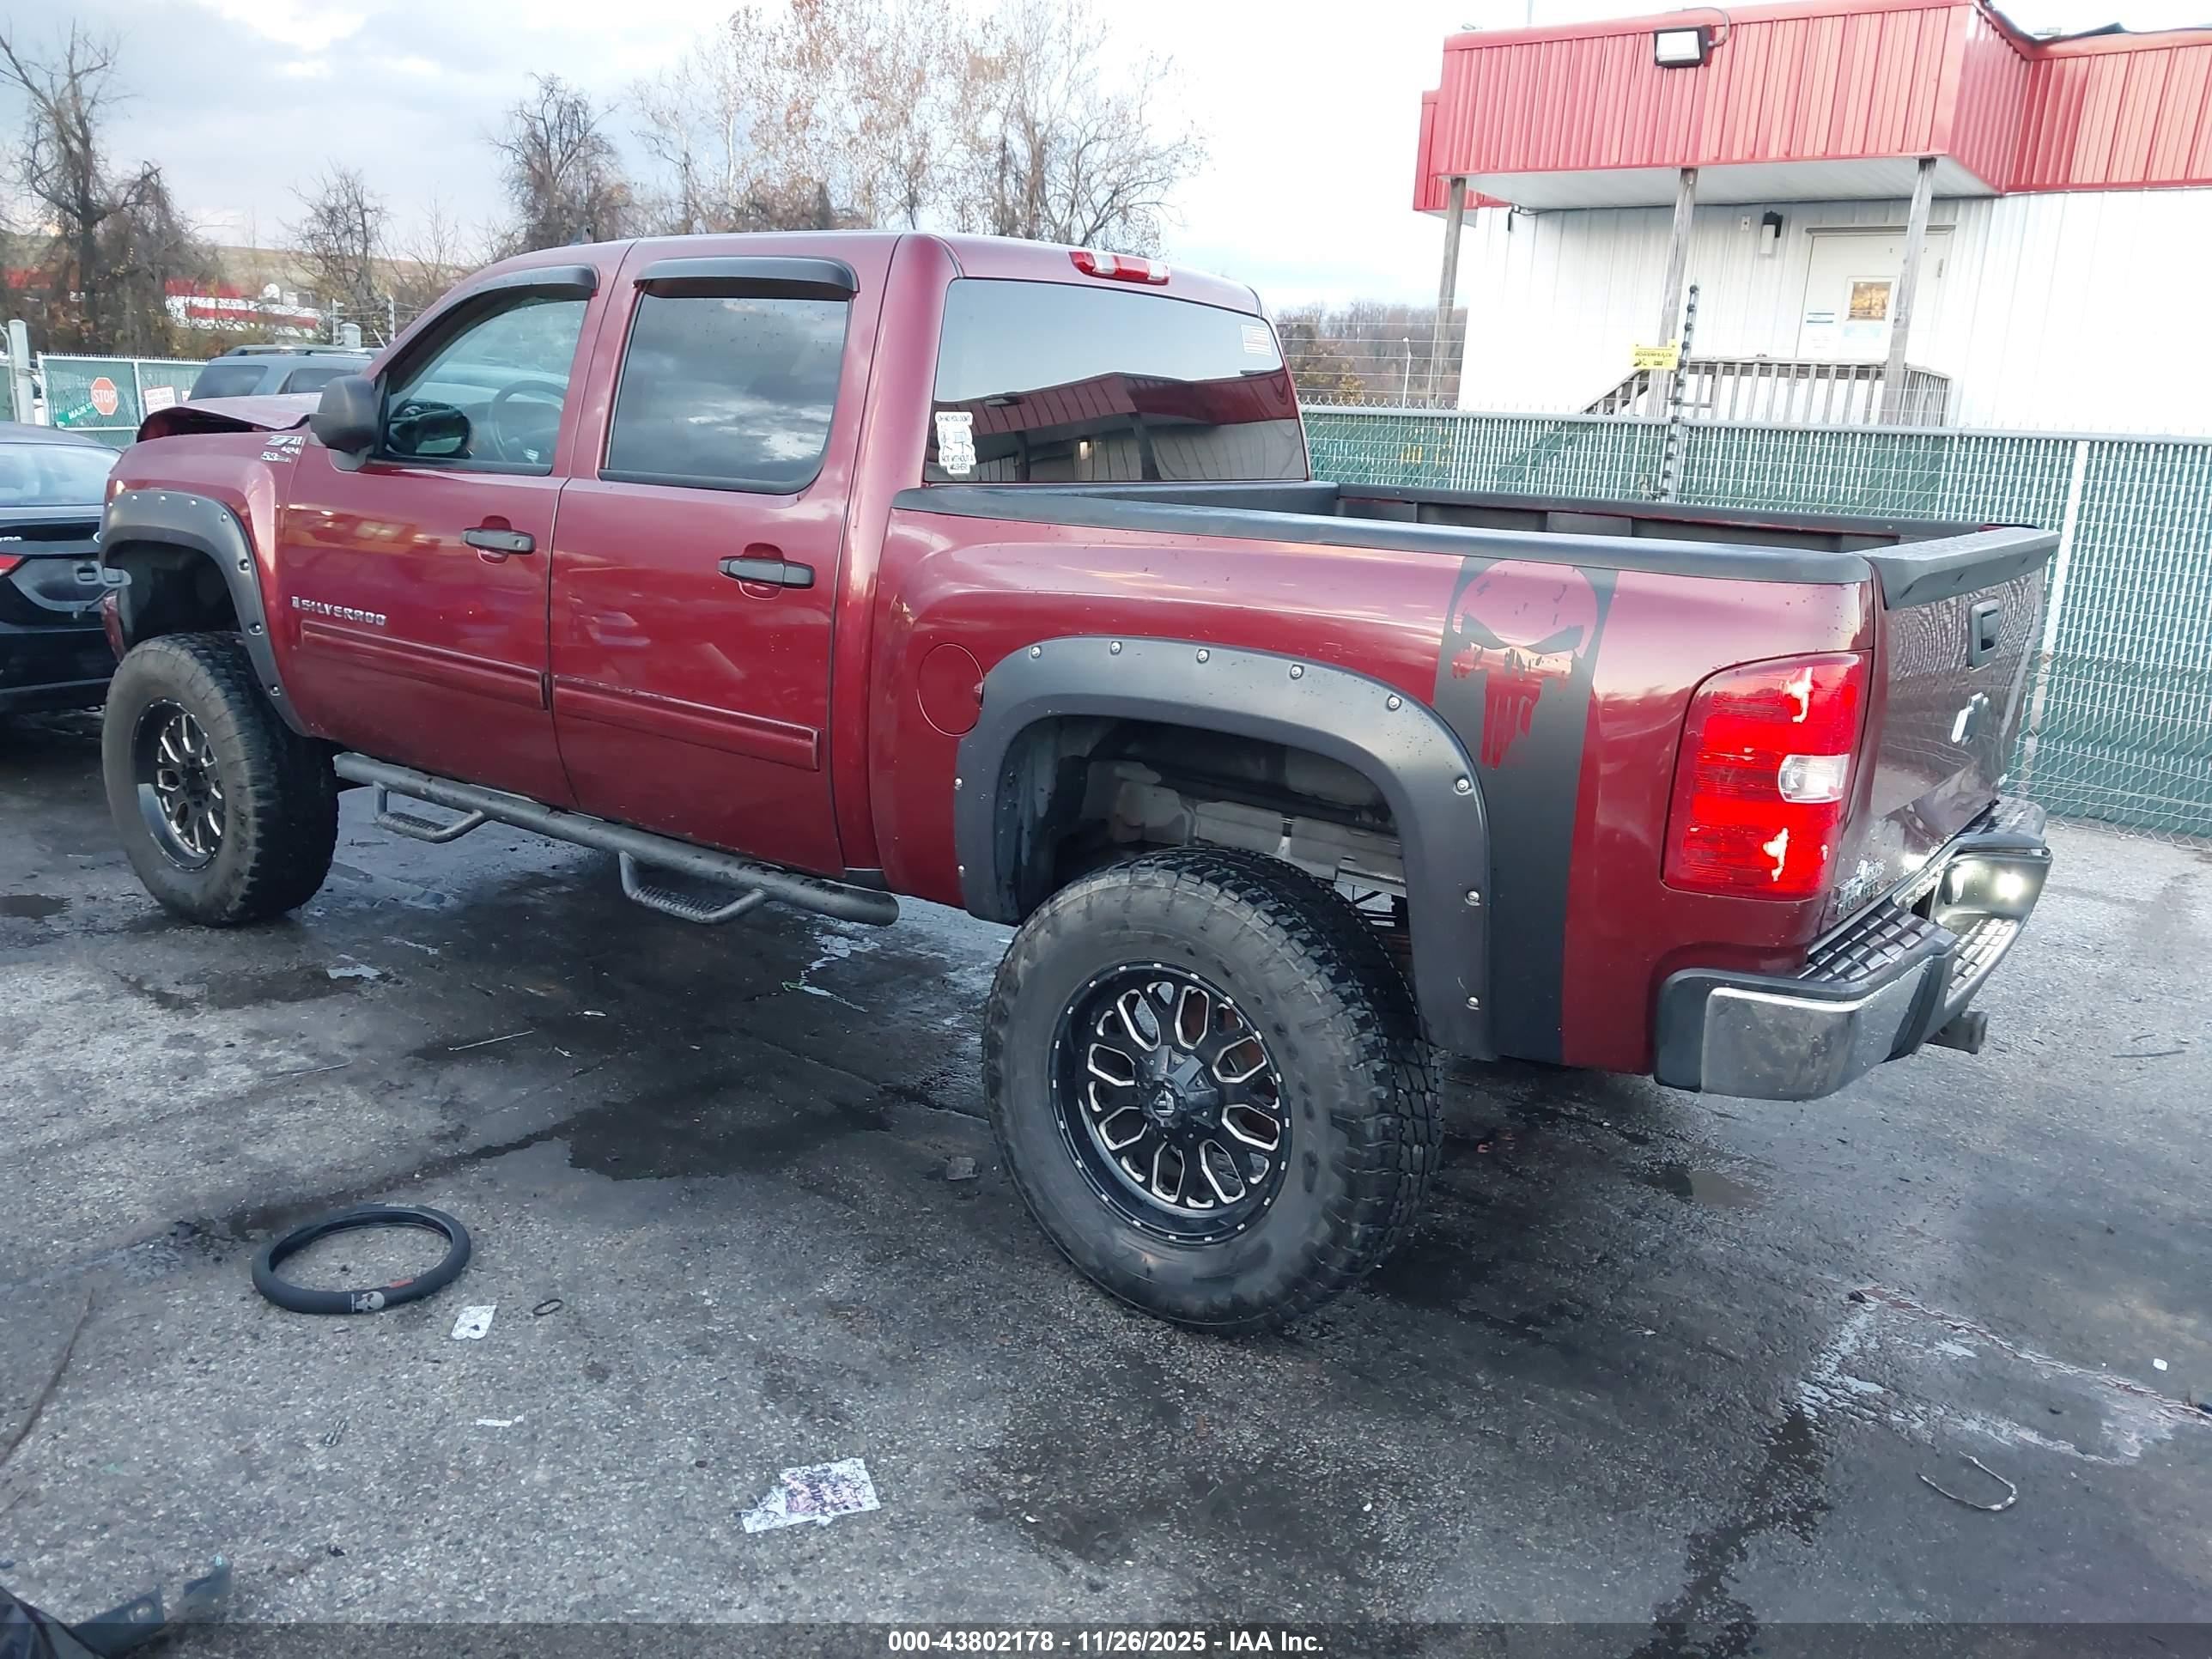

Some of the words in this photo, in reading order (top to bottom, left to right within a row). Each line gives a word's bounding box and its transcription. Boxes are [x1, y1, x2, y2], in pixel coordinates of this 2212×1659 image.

[93, 389, 116, 404] STOP
[68, 405, 87, 419] MAIN
[301, 599, 387, 626] SILVERADO
